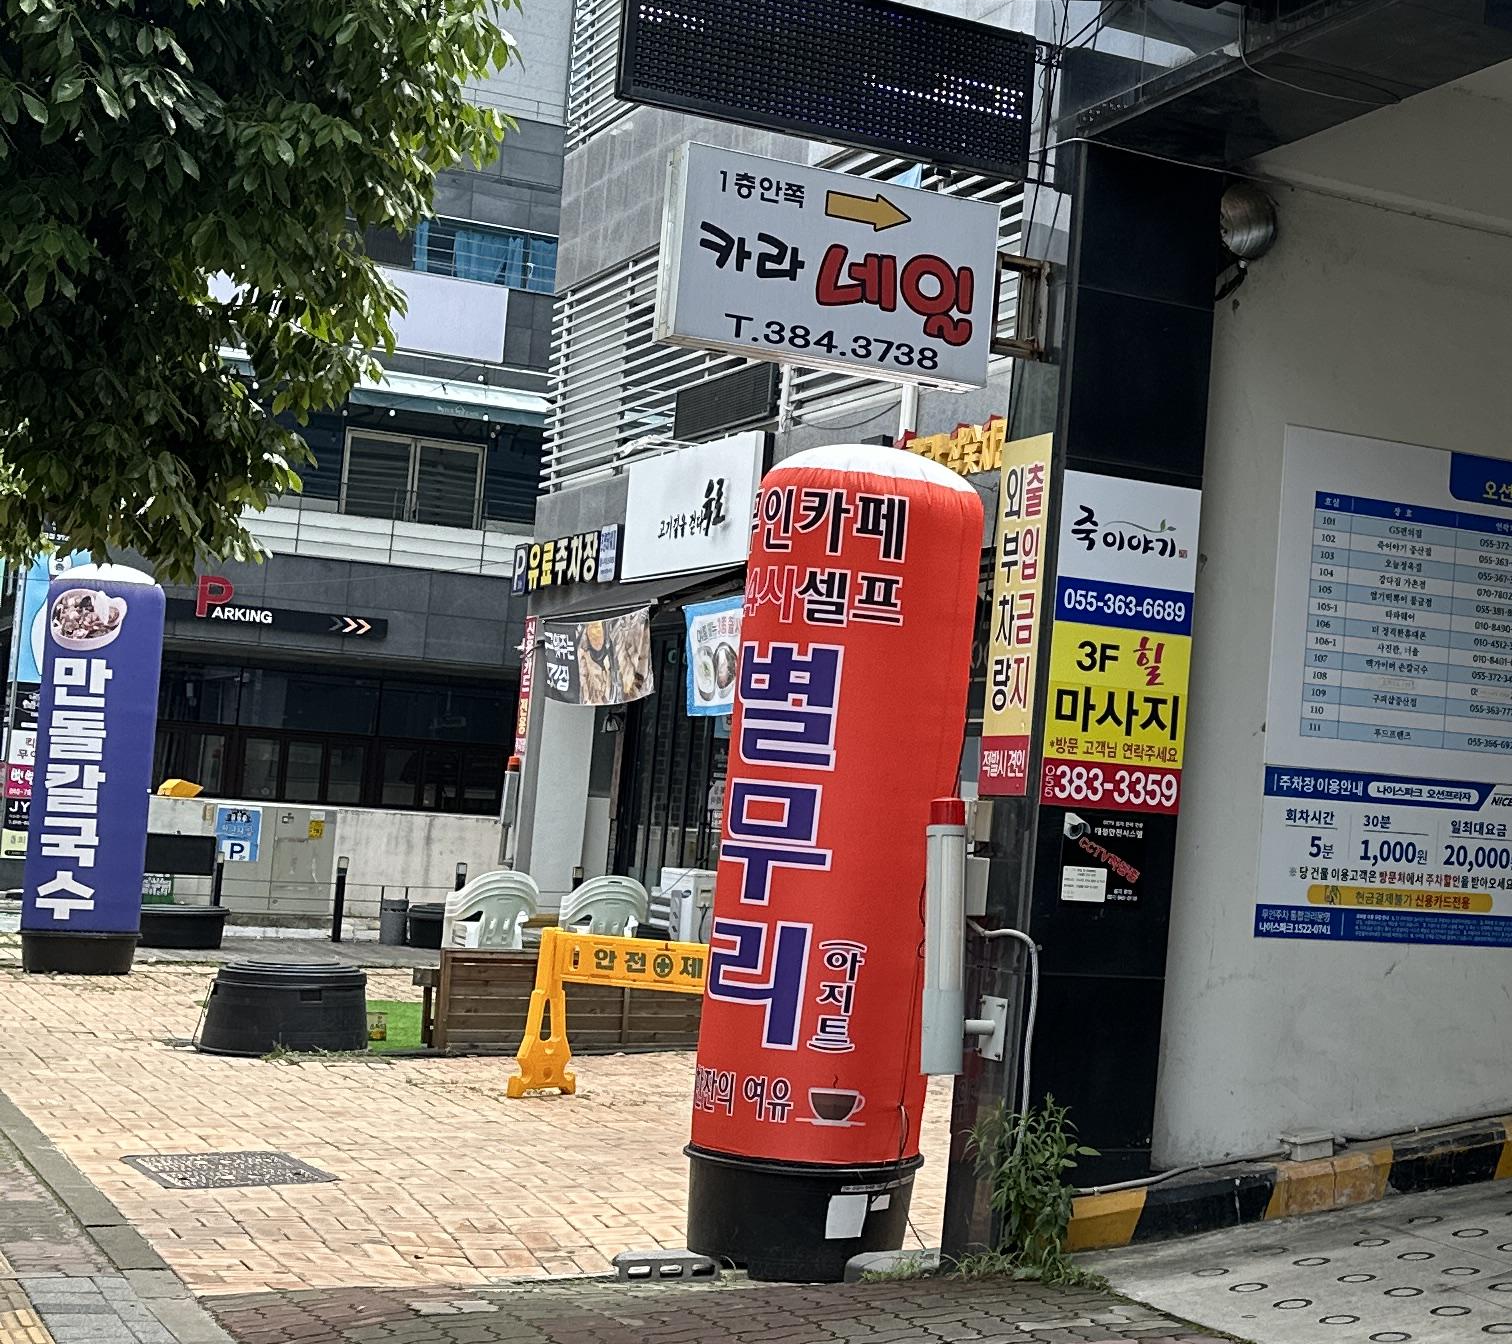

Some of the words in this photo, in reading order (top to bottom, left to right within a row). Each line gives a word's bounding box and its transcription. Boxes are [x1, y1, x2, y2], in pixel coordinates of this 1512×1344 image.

[718, 169, 806, 209] 1층안쪽
[699, 221, 805, 282] 카라
[815, 243, 976, 348] 네일
[724, 313, 939, 371] T.384.3738
[1070, 504, 1177, 559] 죽이야기
[1322, 516, 1336, 525] 101
[1321, 534, 1336, 543] 102
[527, 531, 598, 591] 유료주차장
[1319, 568, 1334, 577] 104
[196, 575, 273, 624] PARKING
[990, 466, 1025, 711] 외부차량
[1010, 464, 1045, 710] 출입금지
[1318, 584, 1332, 594] 105
[1063, 588, 1186, 623] 055-363-6689
[1075, 640, 1120, 673] 3F
[1133, 636, 1166, 687] 힐
[1312, 671, 1328, 680] 108
[1054, 686, 1181, 742] 마사지
[1310, 705, 1324, 714] 110
[1081, 739, 1119, 759] 고객님
[1122, 742, 1179, 764] 연락주세요
[1053, 764, 1178, 806] 383-3359
[1279, 775, 1315, 792] 주차장
[1316, 776, 1364, 797] 이용안내
[1376, 784, 1423, 798] 나이스파크
[1426, 787, 1472, 803] 오션프라자
[1285, 808, 1335, 825] 회차시간
[1363, 814, 1391, 829] 30분
[1450, 819, 1507, 837] 일최대요금
[706, 640, 844, 1051] 별무리
[1308, 835, 1334, 859] 5분
[1359, 839, 1428, 866] 1,000원
[1331, 869, 1377, 883] 이용고객은
[1415, 895, 1470, 910] 신용카드전용
[593, 947, 647, 977] 안전
[742, 1075, 794, 1124] 여유
